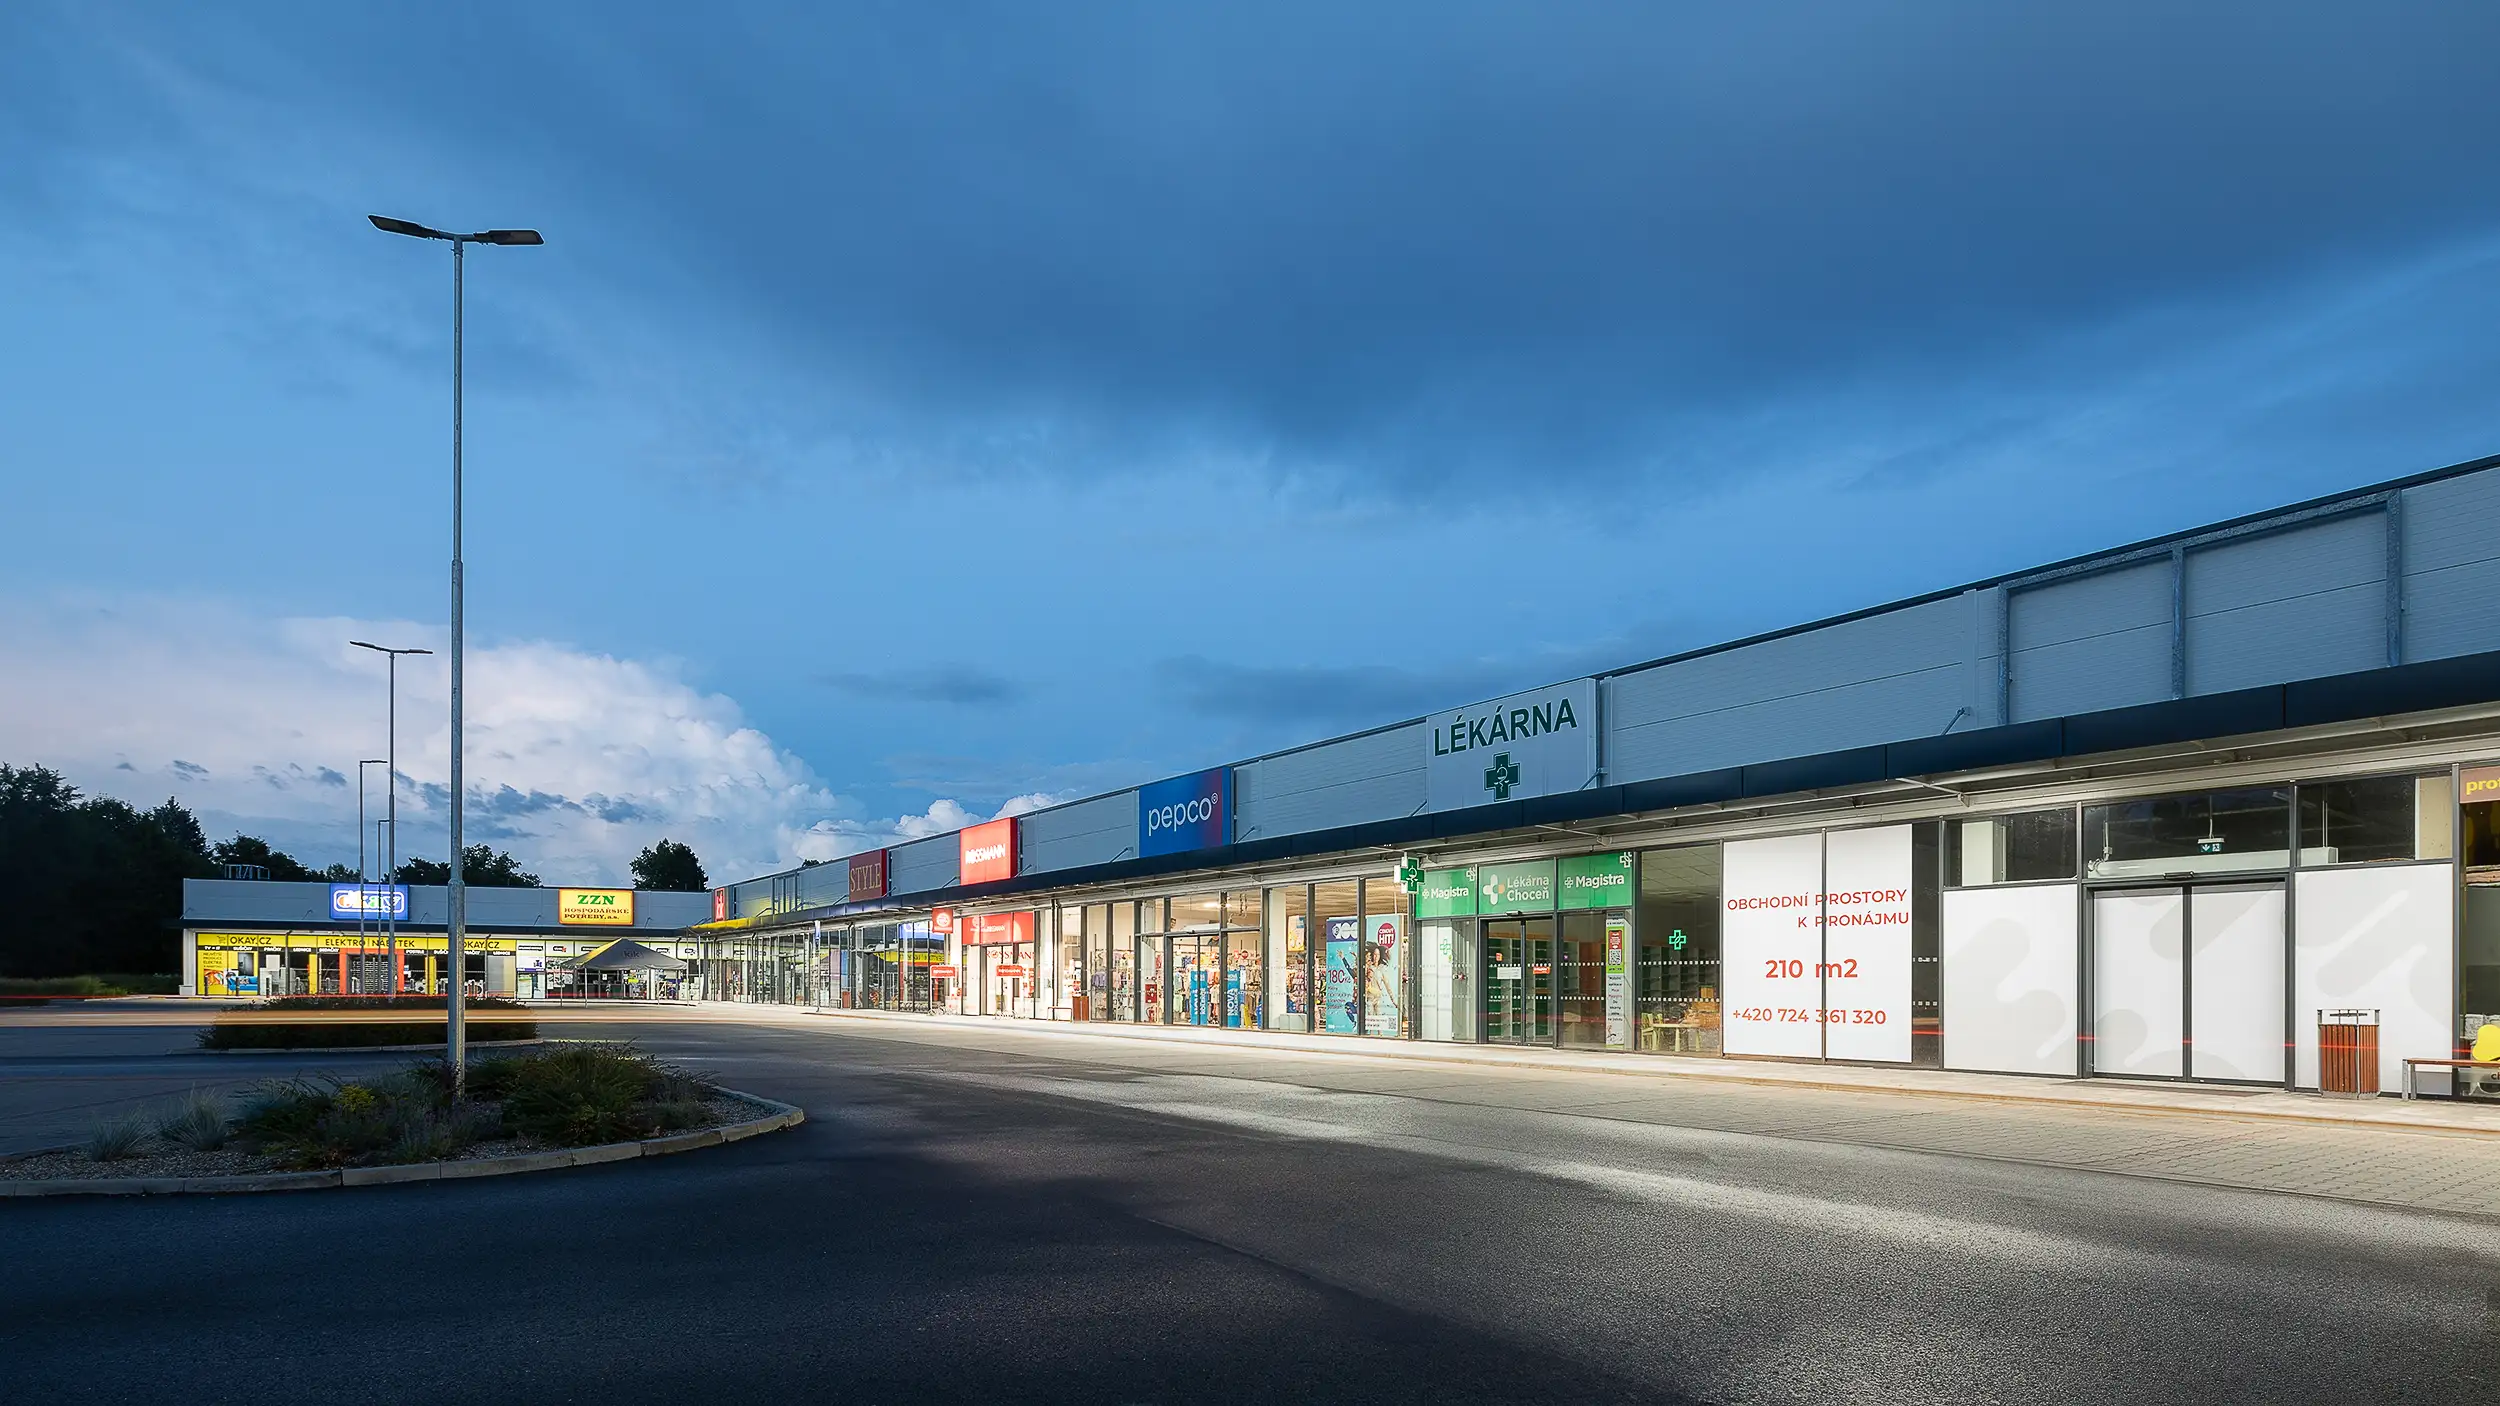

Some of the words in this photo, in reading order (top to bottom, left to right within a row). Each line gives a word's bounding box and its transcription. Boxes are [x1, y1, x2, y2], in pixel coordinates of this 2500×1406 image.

[1434, 698, 1577, 756] LÉKÁRNA
[850, 862, 881, 892] STYLE
[1507, 873, 1549, 888] Lékárna
[1574, 873, 1625, 888] Magistra
[1430, 885, 1469, 898] Magistra
[1506, 886, 1549, 901] Choceň
[577, 895, 615, 905] ZZN
[1727, 892, 1809, 910] OBCHODNÍ
[1815, 889, 1907, 906] PROSTORY
[1797, 916, 1808, 928] K
[1815, 911, 1909, 927] PRONÁJMU
[229, 936, 272, 945] OKAY.CZ
[325, 938, 366, 947] ELEKTRO
[1379, 933, 1394, 944] HIT!
[1765, 959, 1804, 979] 210
[1815, 958, 1858, 978] m2
[1732, 1008, 1772, 1022] +420
[1777, 1008, 1809, 1023] 724
[1815, 1009, 1847, 1024] 361
[1852, 1009, 1887, 1025] 320
